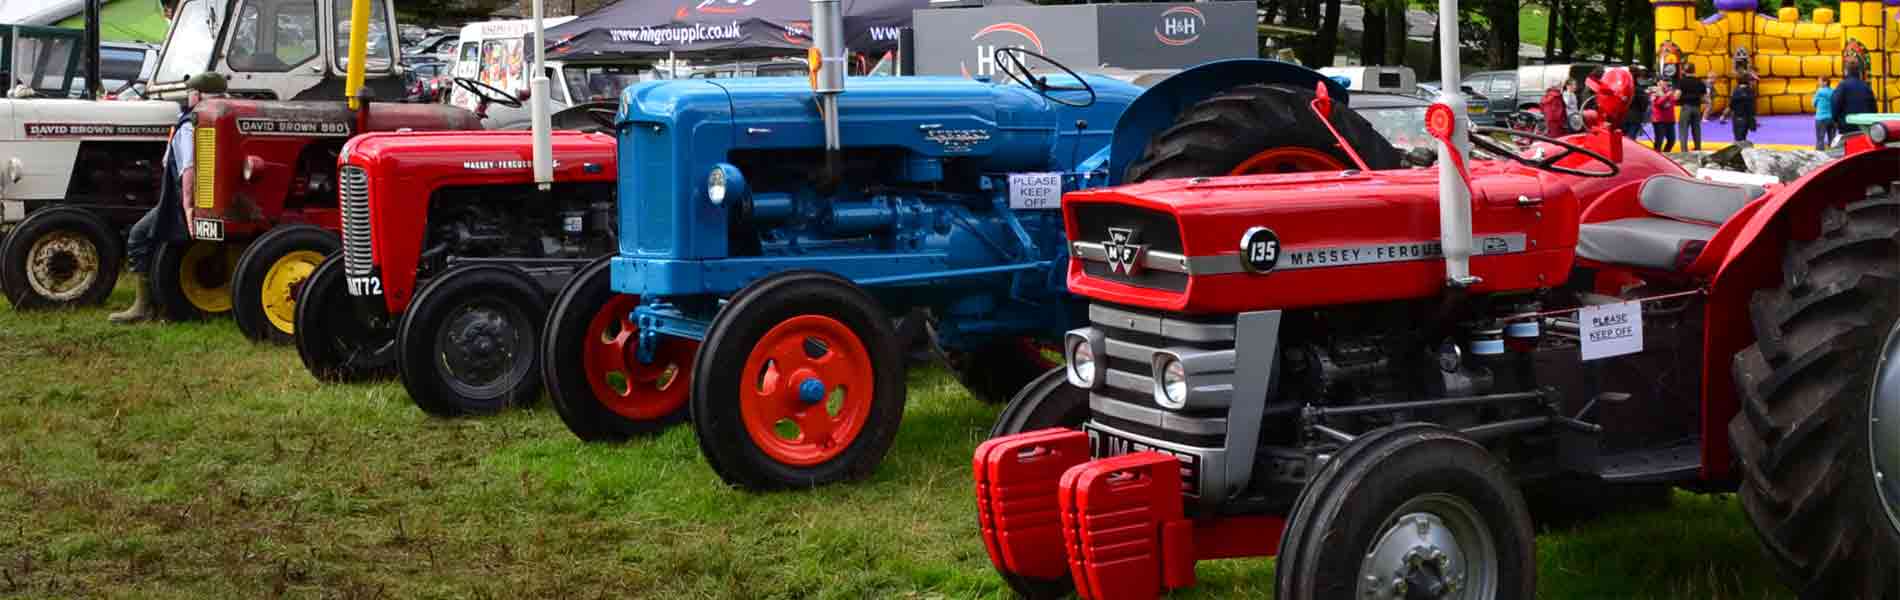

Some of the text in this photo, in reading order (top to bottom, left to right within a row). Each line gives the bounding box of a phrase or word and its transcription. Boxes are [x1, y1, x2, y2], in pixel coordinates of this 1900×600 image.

[609, 20, 741, 45] www.hhgroupplc.co.uk
[1165, 17, 1196, 35] H&H
[30, 126, 68, 134] DAVID
[70, 126, 114, 134] BROWN
[242, 121, 274, 131] DAVID
[279, 122, 317, 132] BROWN
[1013, 176, 1057, 185] PLEASE
[1020, 187, 1050, 197] KEEP
[1023, 198, 1047, 208] OFF
[1250, 241, 1276, 262] 135
[1291, 248, 1361, 265] MASSEY
[1592, 312, 1628, 326] PLEASE
[1589, 327, 1632, 341] KEEP OFF
